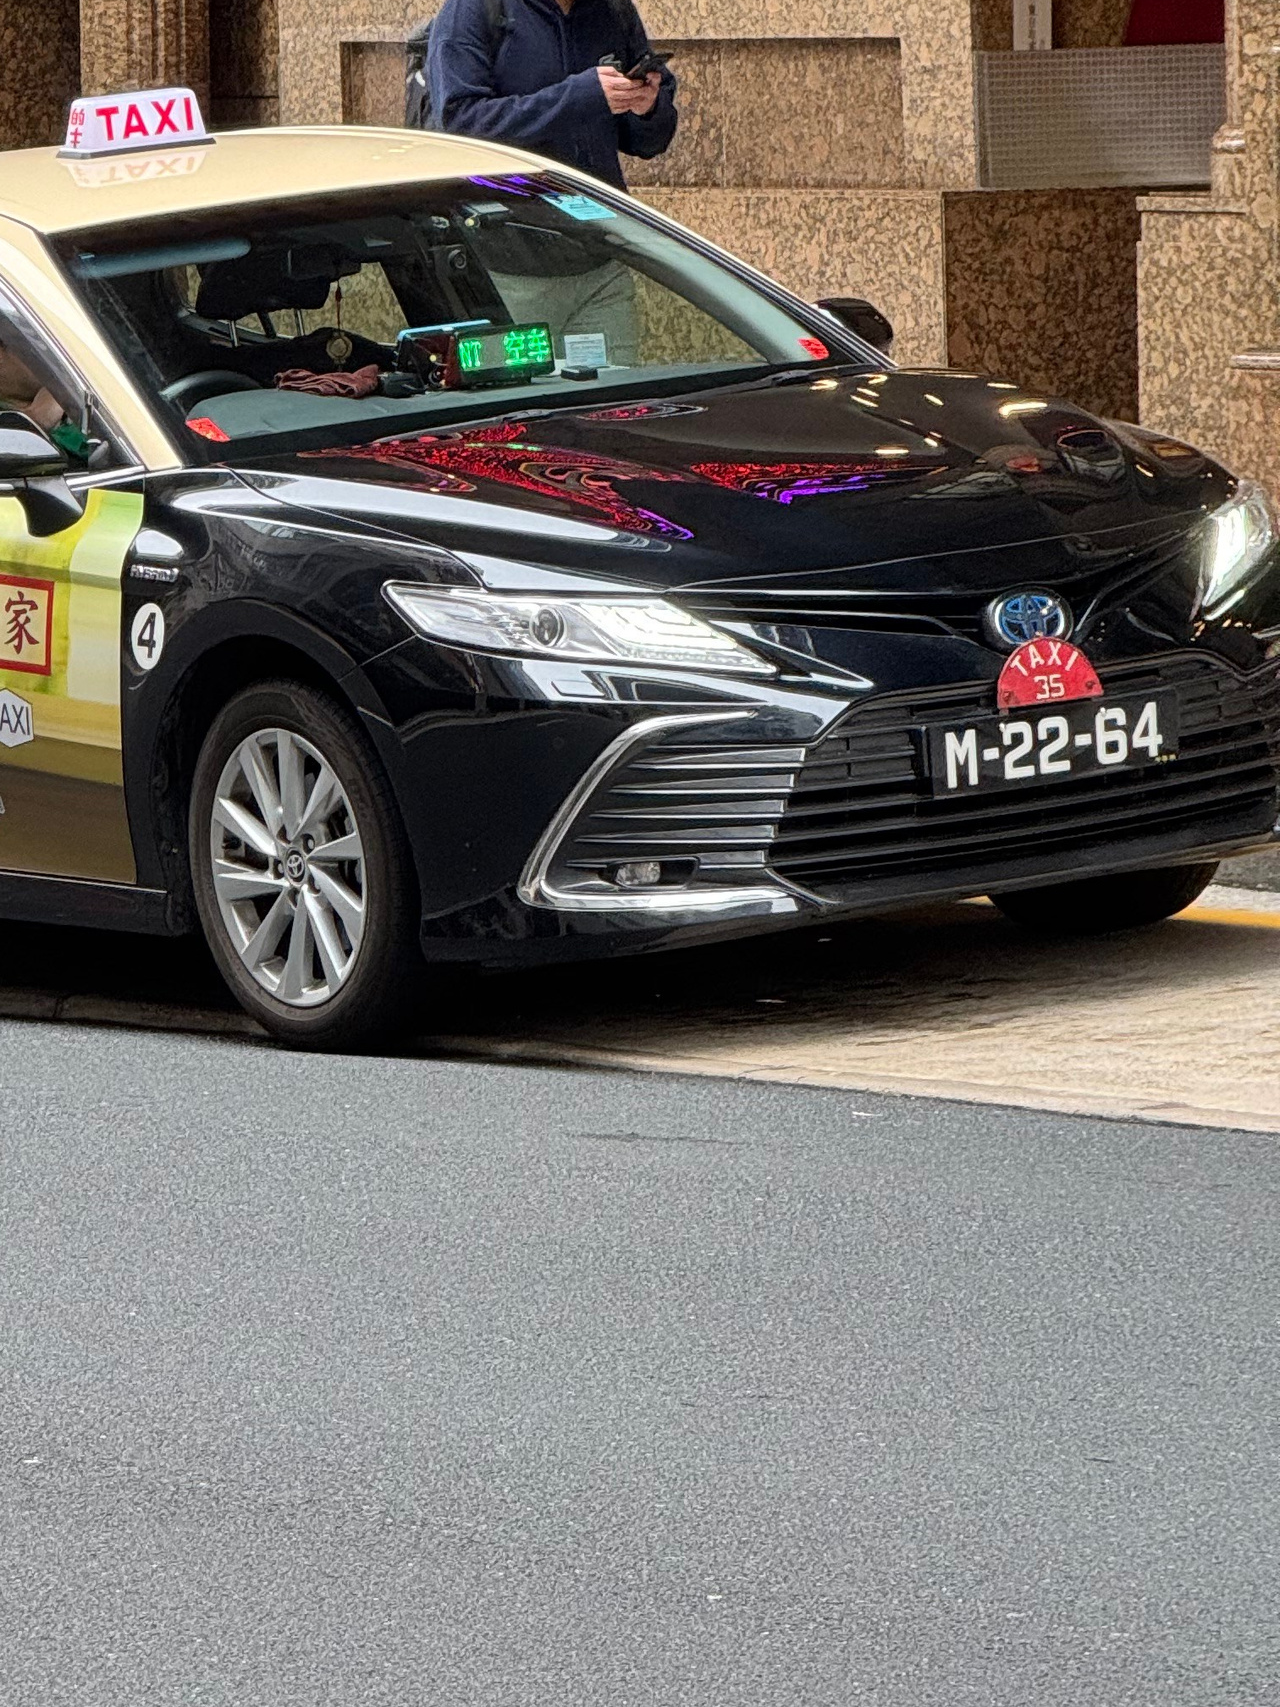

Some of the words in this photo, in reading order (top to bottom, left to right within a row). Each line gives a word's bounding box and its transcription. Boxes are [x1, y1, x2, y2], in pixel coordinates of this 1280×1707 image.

[70, 107, 86, 149] 的士
[95, 96, 195, 142] TAXI
[137, 612, 157, 659] 4
[1010, 641, 1079, 677] TAXI
[1033, 674, 1065, 699] 35
[944, 701, 1163, 788] M-22-64
